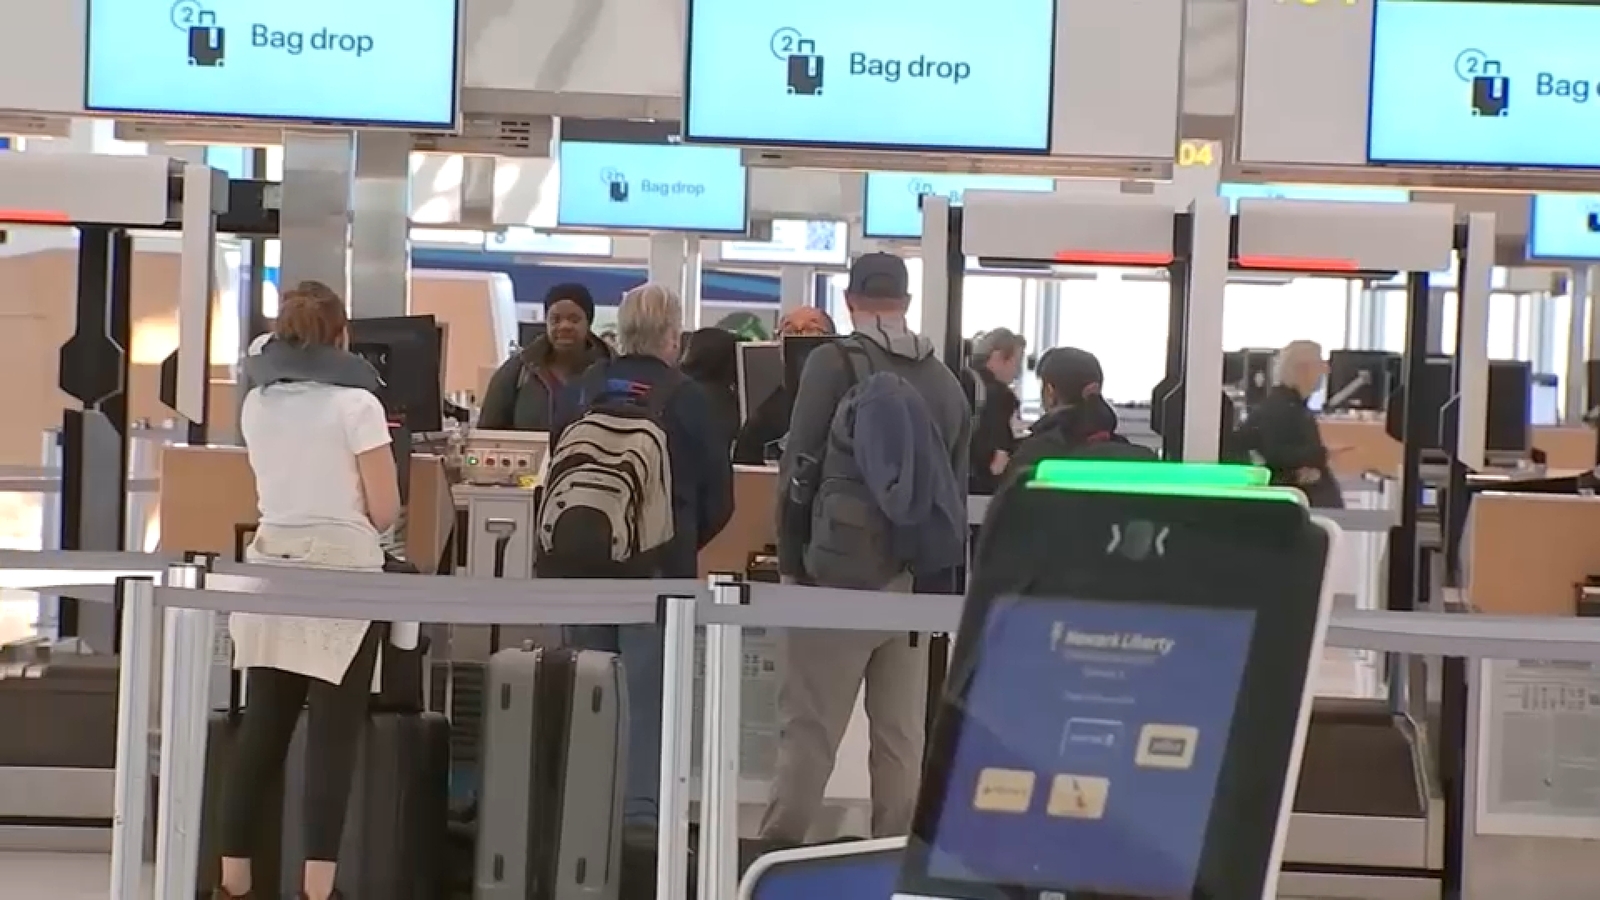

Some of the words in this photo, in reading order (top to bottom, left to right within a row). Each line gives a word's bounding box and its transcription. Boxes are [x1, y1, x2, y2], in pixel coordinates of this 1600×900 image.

[180, 6, 194, 23] 2
[251, 23, 304, 55] Bag
[309, 27, 374, 57] drop
[780, 35, 793, 52] 2
[849, 52, 901, 82] Bag
[907, 54, 971, 84] drop
[1466, 57, 1478, 73] 2
[1536, 72, 1590, 103] Bag
[641, 179, 669, 196] Bag
[672, 181, 705, 198] drop
